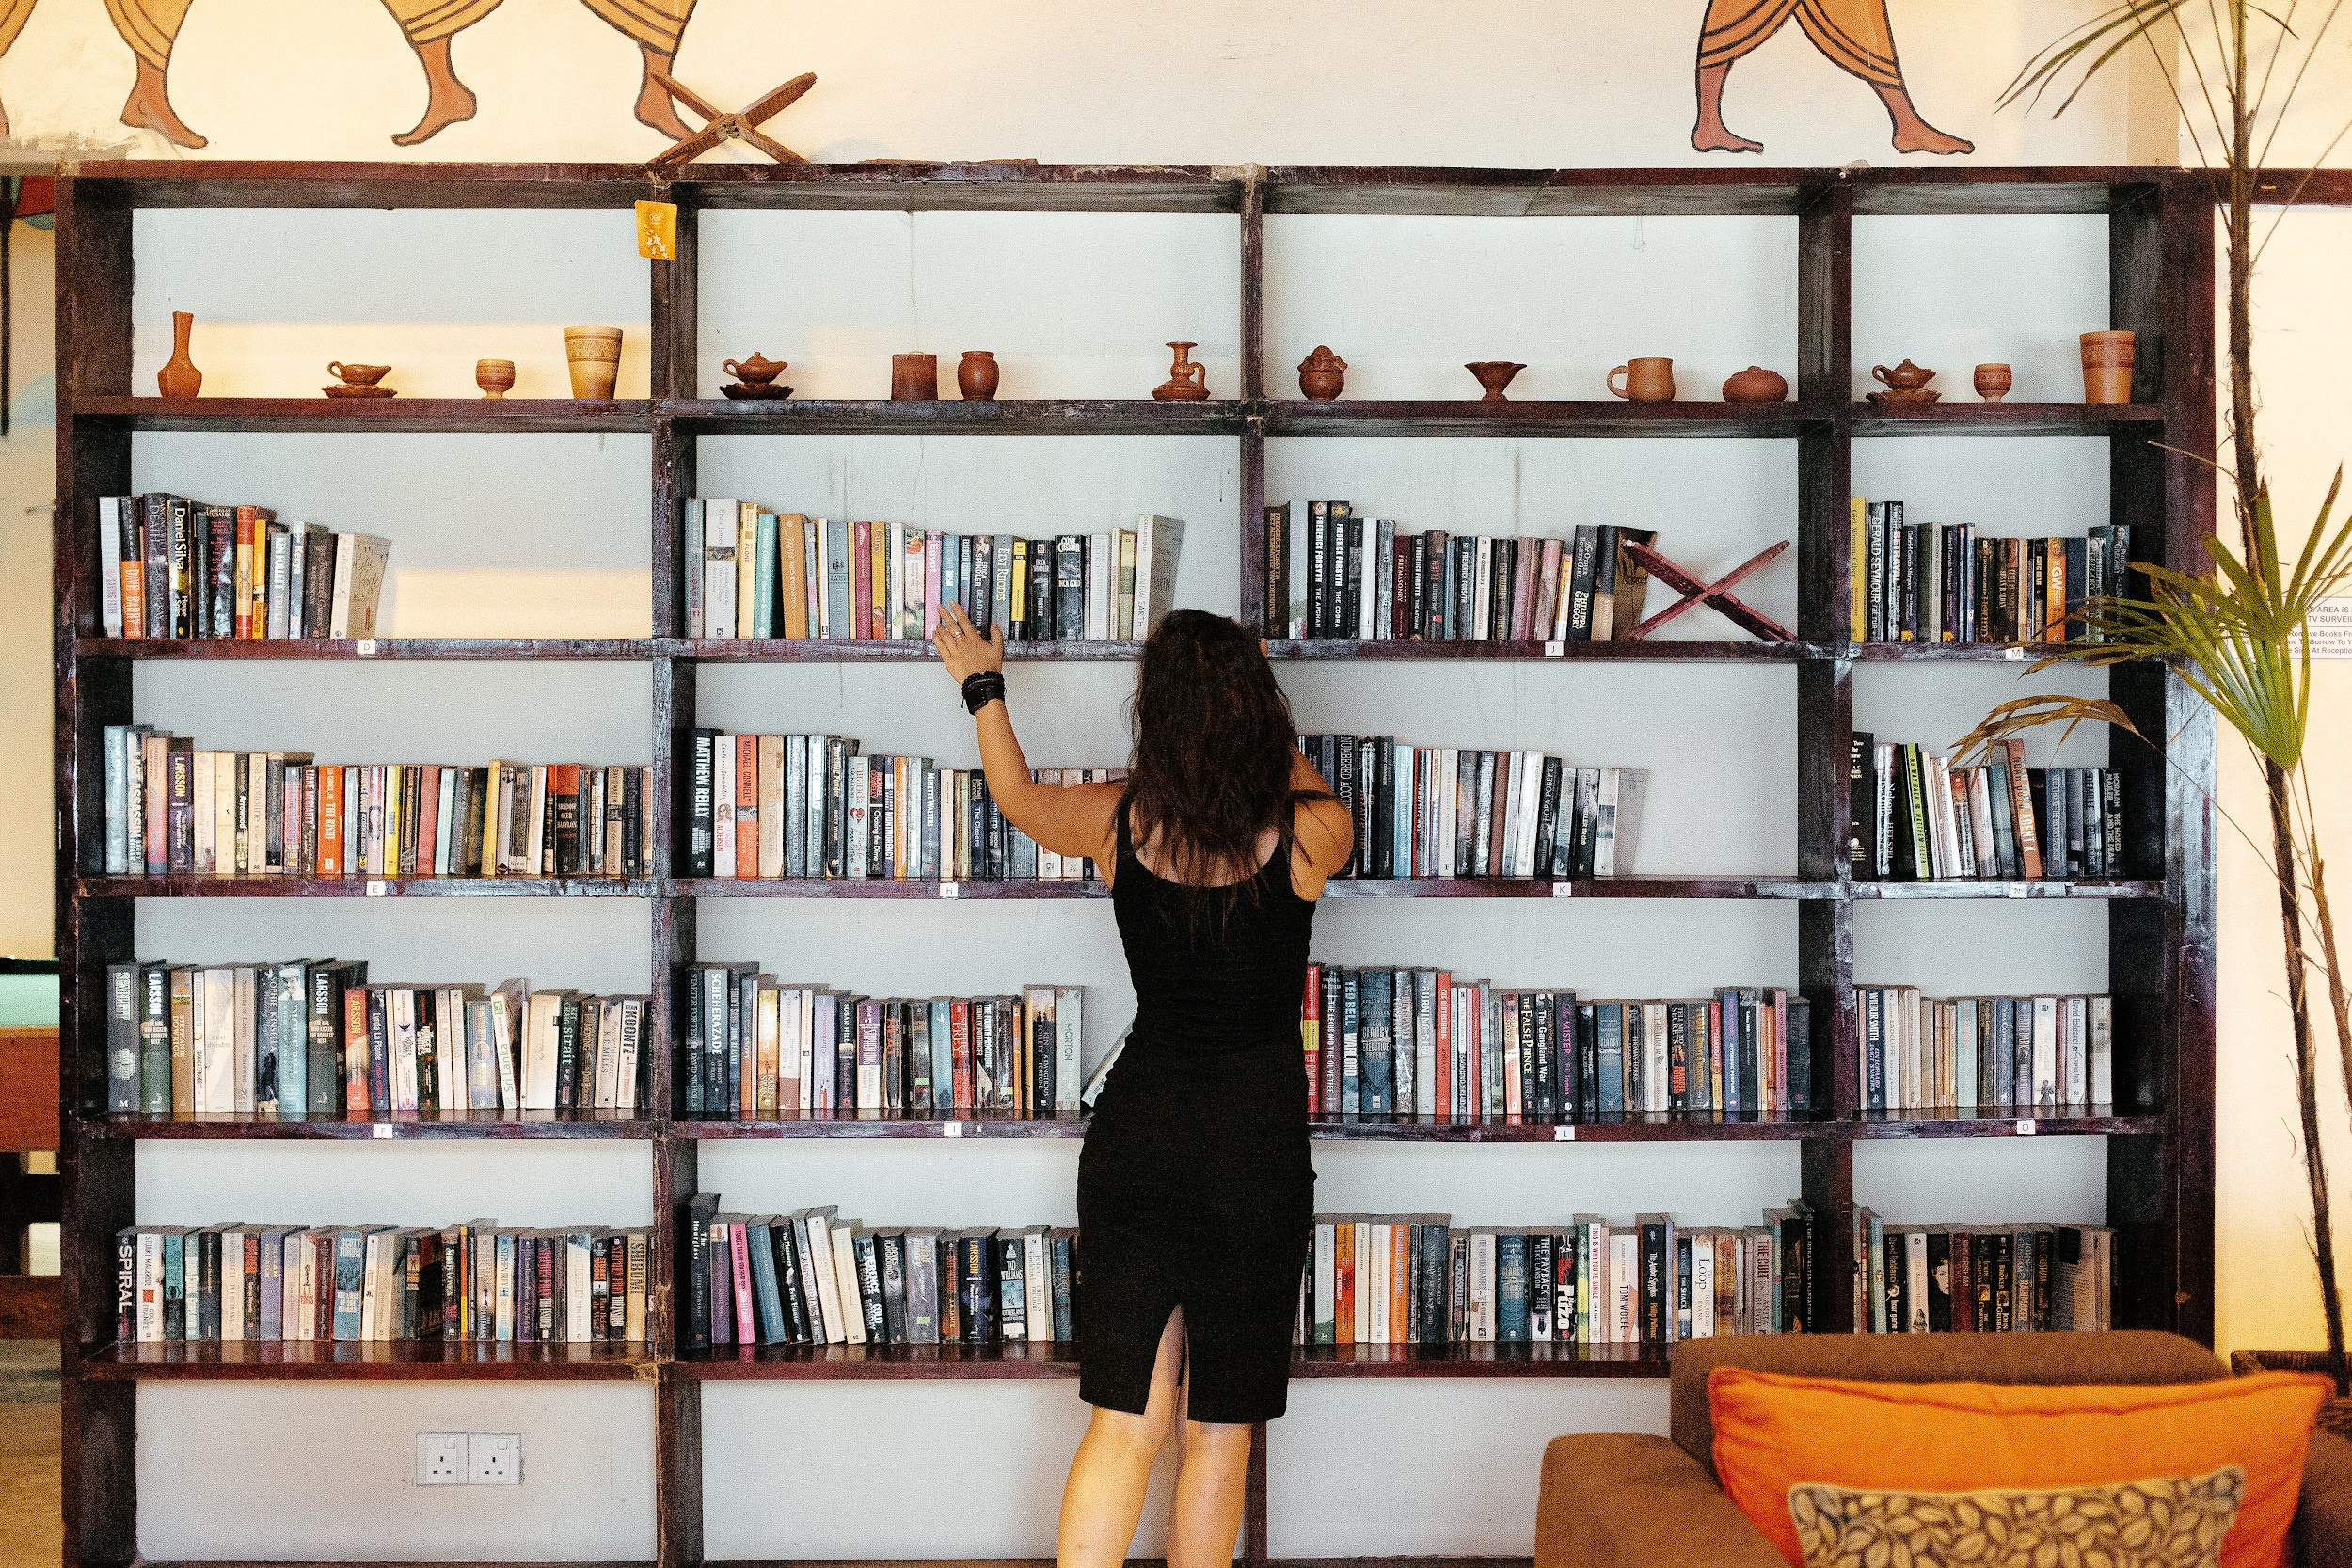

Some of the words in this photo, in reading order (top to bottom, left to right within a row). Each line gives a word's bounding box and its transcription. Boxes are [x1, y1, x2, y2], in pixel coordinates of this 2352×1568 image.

[149, 504, 161, 543] DEATH
[174, 507, 186, 542] Daniel
[1314, 516, 1325, 549] FREDERICK
[1869, 517, 1882, 556] GERALD
[274, 537, 285, 554] KEN
[1335, 523, 1344, 555] FREDERICK
[174, 543, 188, 570] Silva
[294, 546, 304, 575] Kenya
[929, 543, 940, 573] Egypt
[974, 553, 983, 587] SPINDLER
[1314, 550, 1325, 583] FORSYTH
[1461, 551, 1470, 579] FREDERICK
[1582, 553, 1591, 576] OTHER
[125, 569, 139, 591] DAVE
[274, 555, 285, 591] FOLLETT
[996, 568, 1009, 601] RHODES
[1334, 556, 1344, 587] FORSYTH
[1869, 557, 1882, 603] SEYMOUR
[2051, 566, 2063, 591] GW
[976, 589, 984, 609] DEAD
[1460, 580, 1470, 604] FORSYTH
[126, 596, 140, 625] BARRY
[1571, 591, 1582, 630] GREGORY
[1578, 592, 1590, 628] PHILIPPA
[130, 752, 142, 780] LAST
[696, 736, 711, 786] MATTHEW
[742, 741, 753, 768] MICHAEL
[1340, 736, 1353, 779] NUMBERED
[174, 756, 186, 797] LARSSON
[305, 769, 315, 790] LIANE
[742, 771, 753, 802] CONNELLY
[926, 772, 935, 799] MINETTE
[2113, 773, 2122, 808] NORMAN
[130, 782, 142, 837] ASSASSIN
[253, 776, 264, 821] Scottoline
[695, 787, 710, 817] REILLY
[872, 810, 882, 834] Chasing
[926, 800, 935, 827] WALTERS
[2021, 813, 2034, 843] AGENT
[716, 825, 724, 852] ALDERSON
[812, 828, 820, 857] REVERSAL
[873, 835, 882, 844] the
[885, 811, 894, 861] MONTMORENCY
[974, 821, 982, 847] Closers
[873, 845, 882, 862] Dime
[148, 974, 162, 1015] LARSSON
[315, 974, 328, 1014] LARSSON
[690, 973, 699, 1006] STARTER
[1344, 980, 1357, 1000] TED
[350, 994, 362, 1034] LARSSON
[690, 1007, 699, 1025] FOR
[711, 973, 722, 1055] SCHEHERAZADE
[1344, 1001, 1357, 1026] BELL
[1421, 986, 1430, 1030] BURNING
[1537, 1009, 1547, 1022] The
[1868, 992, 1879, 1019] WILBUR
[622, 1010, 637, 1055] KOONTZ
[1521, 1010, 1533, 1038] FALSE
[1562, 1020, 1573, 1054] MISTER
[1671, 1007, 1679, 1045] SECRETS
[1868, 1020, 1880, 1041] SMITH
[2072, 1018, 2082, 1045] Baldacci
[562, 1027, 575, 1065] strait
[862, 1028, 879, 1052] STEPHEN
[1063, 1023, 1073, 1061] MORTON
[1343, 1032, 1358, 1077] WARLORD
[1537, 1026, 1548, 1064] Gangland
[691, 1053, 699, 1074] DAVID
[861, 1052, 878, 1065] KING
[1521, 1039, 1534, 1074] PRINCE
[1538, 1066, 1548, 1083] War
[1564, 1074, 1572, 1096] James
[691, 1075, 699, 1109] NICHOLLS
[144, 1235, 153, 1257] STUART
[691, 1220, 701, 1260] Hourglass
[1534, 1244, 1543, 1260] MIKE
[1540, 1238, 1550, 1254] THE
[1756, 1239, 1771, 1257] THE
[500, 1247, 509, 1273] STEPHEN
[611, 1245, 625, 1276] STEPHEN
[629, 1243, 644, 1294] SHIBUMI
[969, 1239, 979, 1274] LARSSON
[1756, 1258, 1771, 1280] CULT
[119, 1244, 134, 1314] SPIRAL
[144, 1258, 153, 1287] MACBRIDE
[500, 1273, 509, 1286] FREY
[611, 1278, 625, 1295] FREY
[866, 1255, 881, 1294] TERENCE
[1534, 1261, 1543, 1289] LAWSON
[1540, 1257, 1550, 1295] PAYBACK
[1694, 1258, 1711, 1291] Loop
[1998, 1264, 2007, 1289] BROKER
[1591, 1280, 1599, 1300] SINGLE
[1619, 1285, 1629, 1303] TOM
[1680, 1287, 1689, 1309] SHACK
[2018, 1279, 2030, 1321] RAINMAKER
[873, 1302, 883, 1323] COLD
[1557, 1284, 1575, 1330] Puzo
[1618, 1304, 1629, 1331] WOLFE
[2002, 1312, 2010, 1329] JOHN
